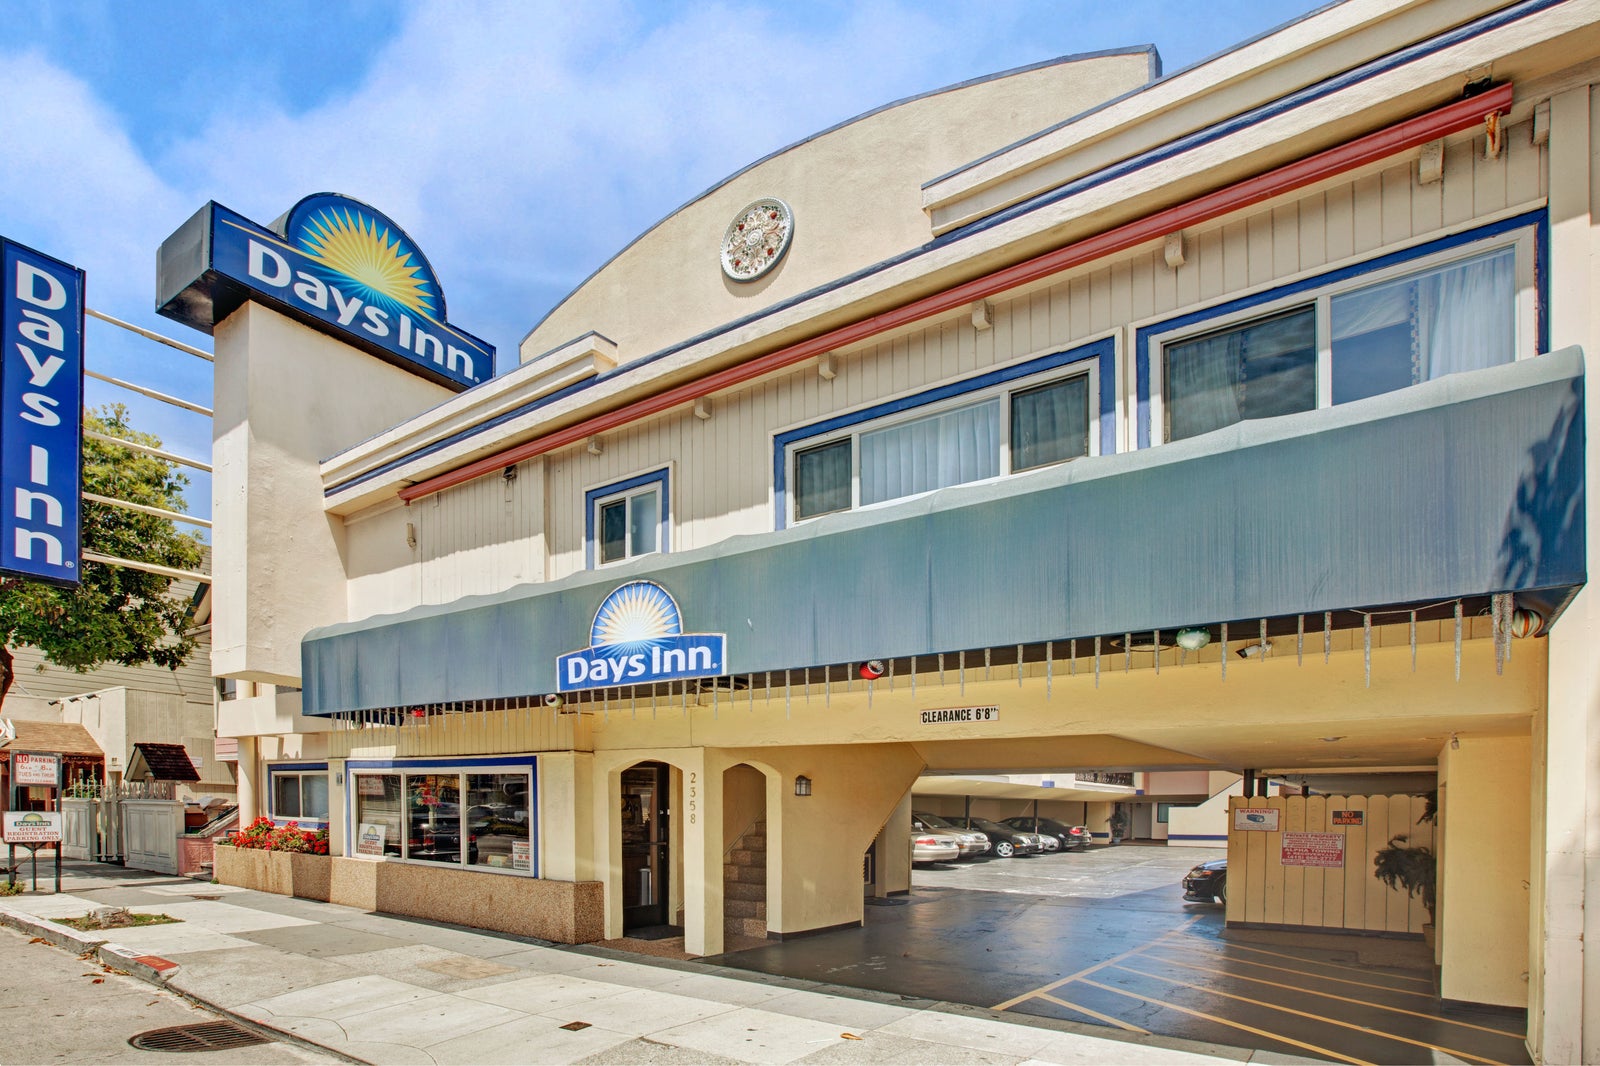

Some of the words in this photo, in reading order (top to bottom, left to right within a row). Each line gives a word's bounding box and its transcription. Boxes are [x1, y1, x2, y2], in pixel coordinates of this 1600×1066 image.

[247, 238, 390, 339] Days
[399, 315, 475, 382] Inn
[15, 260, 67, 427] Days
[14, 444, 64, 566] Inn
[567, 653, 646, 684] Days
[651, 645, 712, 674] Inn
[922, 708, 972, 723] CLEARANCE
[16, 754, 29, 763] NO
[30, 756, 56, 764] PARKING
[689, 772, 697, 824] 2358
[1333, 817, 1362, 825] PARKING
